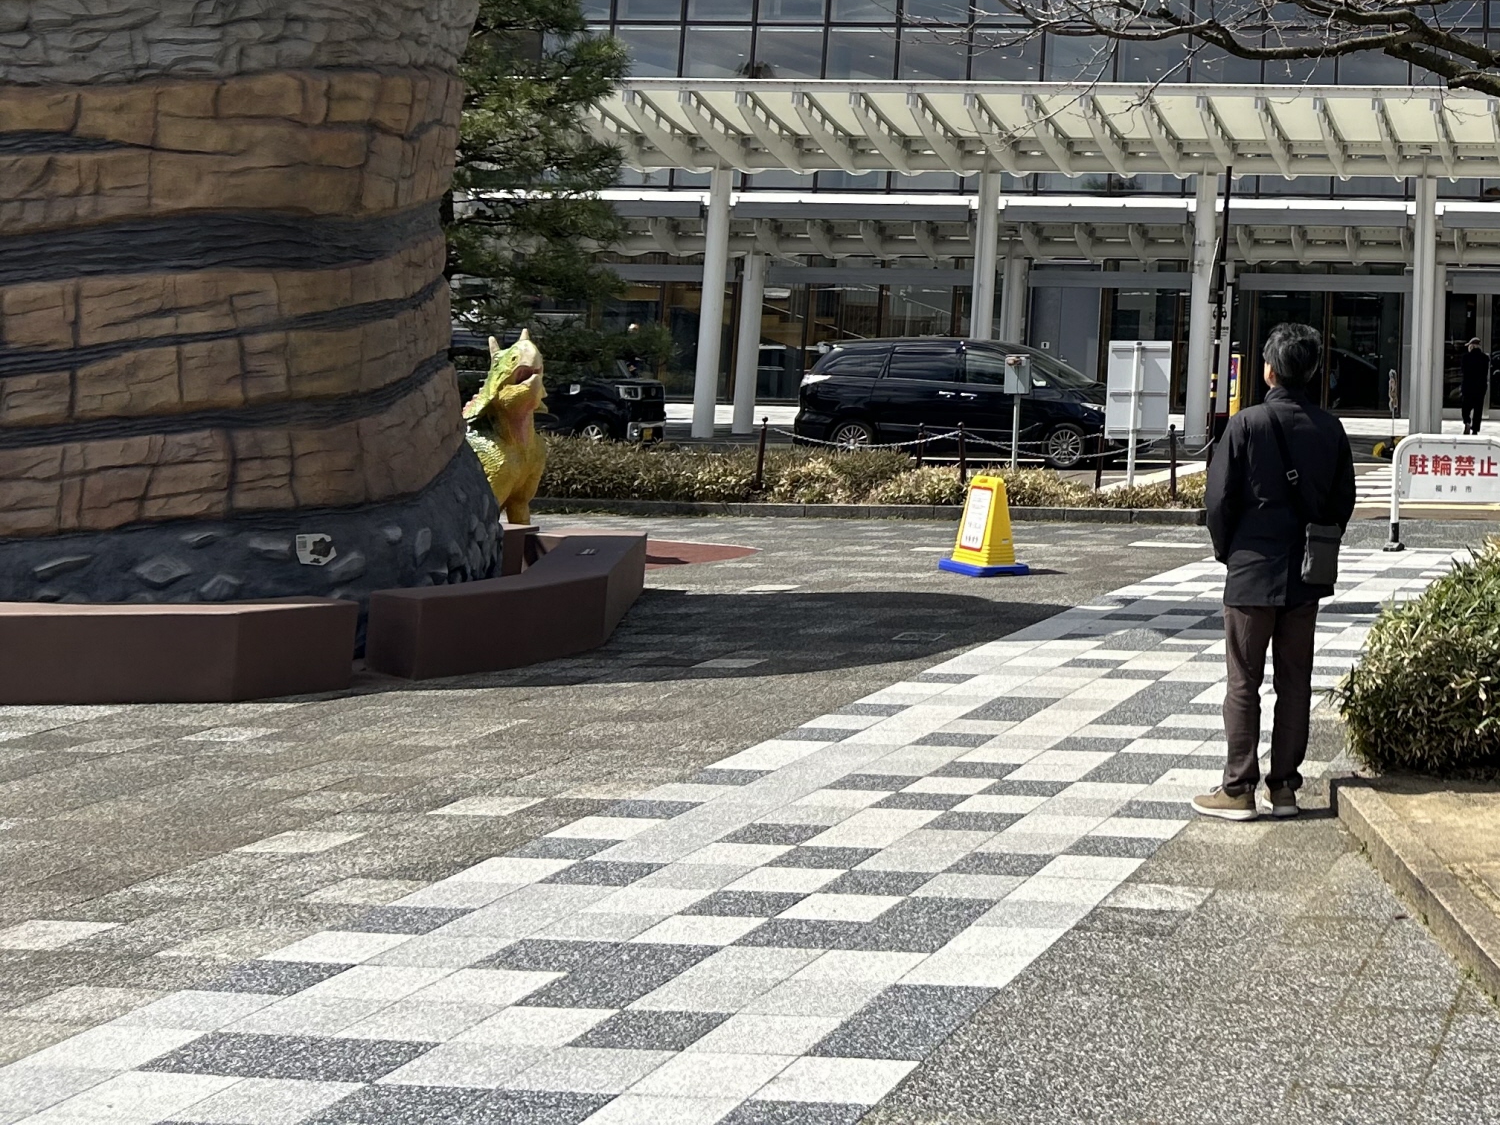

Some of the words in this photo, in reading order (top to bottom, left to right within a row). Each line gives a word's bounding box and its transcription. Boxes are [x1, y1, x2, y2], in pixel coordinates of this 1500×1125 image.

[1407, 453, 1499, 477] 駐輪禁止
[1435, 484, 1473, 493] 福井市
